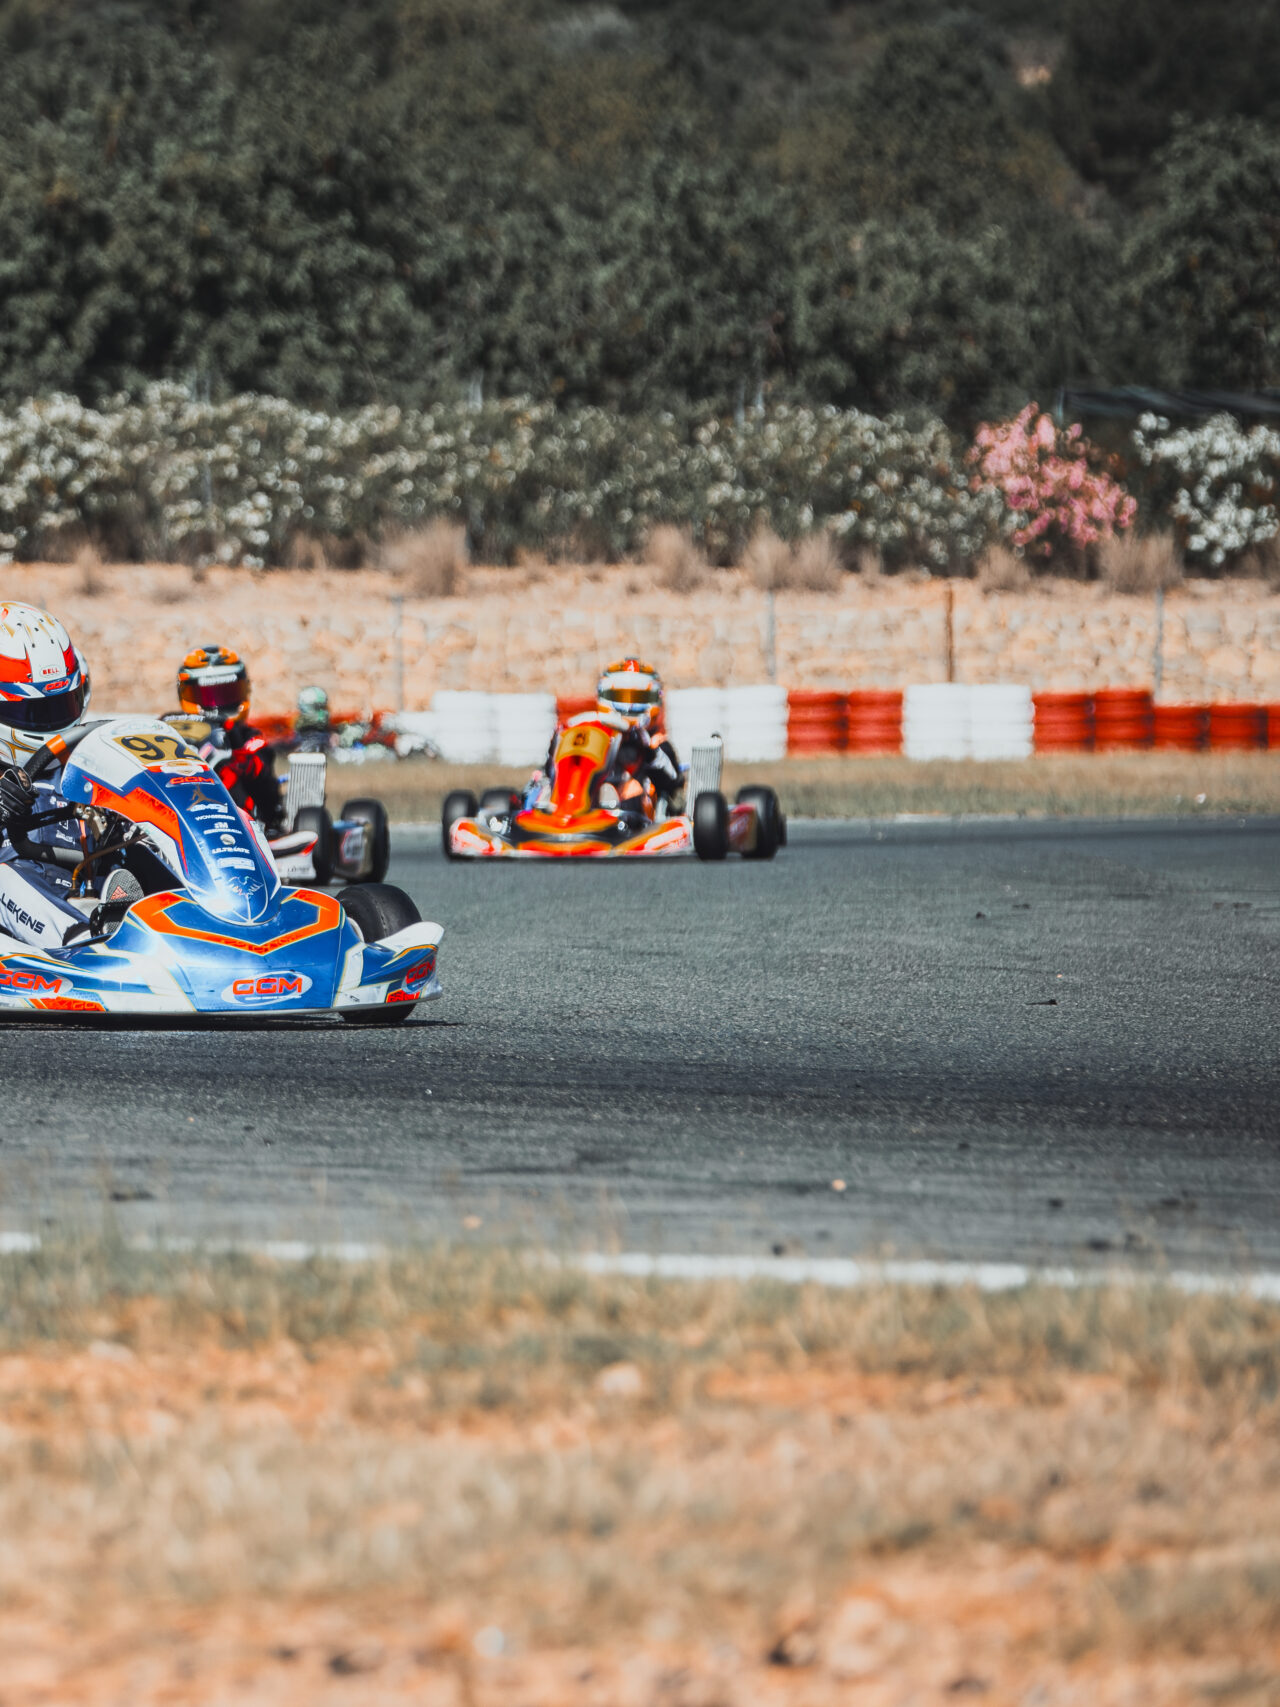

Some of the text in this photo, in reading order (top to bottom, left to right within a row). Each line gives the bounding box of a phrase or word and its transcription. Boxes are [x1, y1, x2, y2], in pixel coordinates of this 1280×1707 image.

[42, 666, 60, 675] BELL
[120, 735, 204, 761] 92
[169, 775, 215, 785] GGM
[405, 957, 437, 985] GGM
[232, 976, 303, 996] GGM
